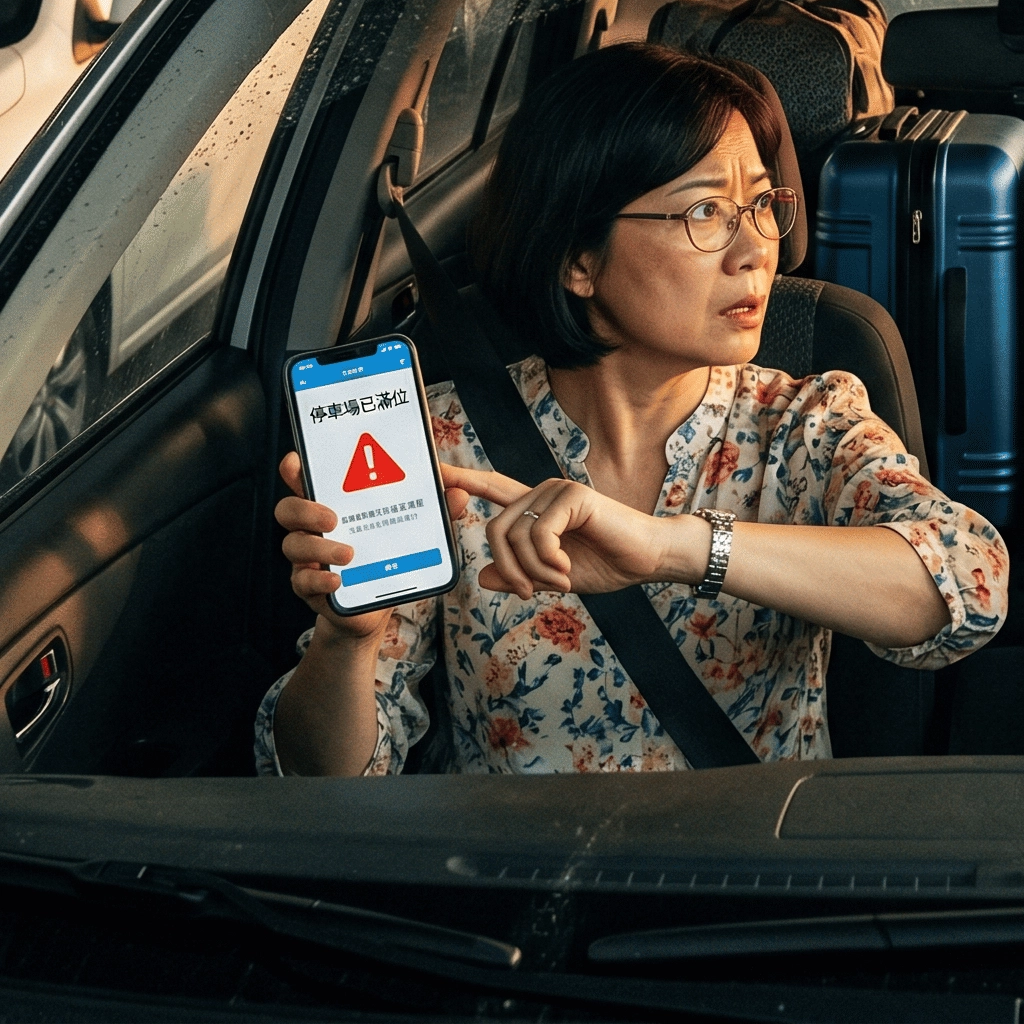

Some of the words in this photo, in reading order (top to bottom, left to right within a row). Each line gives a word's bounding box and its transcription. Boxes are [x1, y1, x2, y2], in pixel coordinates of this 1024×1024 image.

[309, 388, 410, 423] 停車場已滿位
